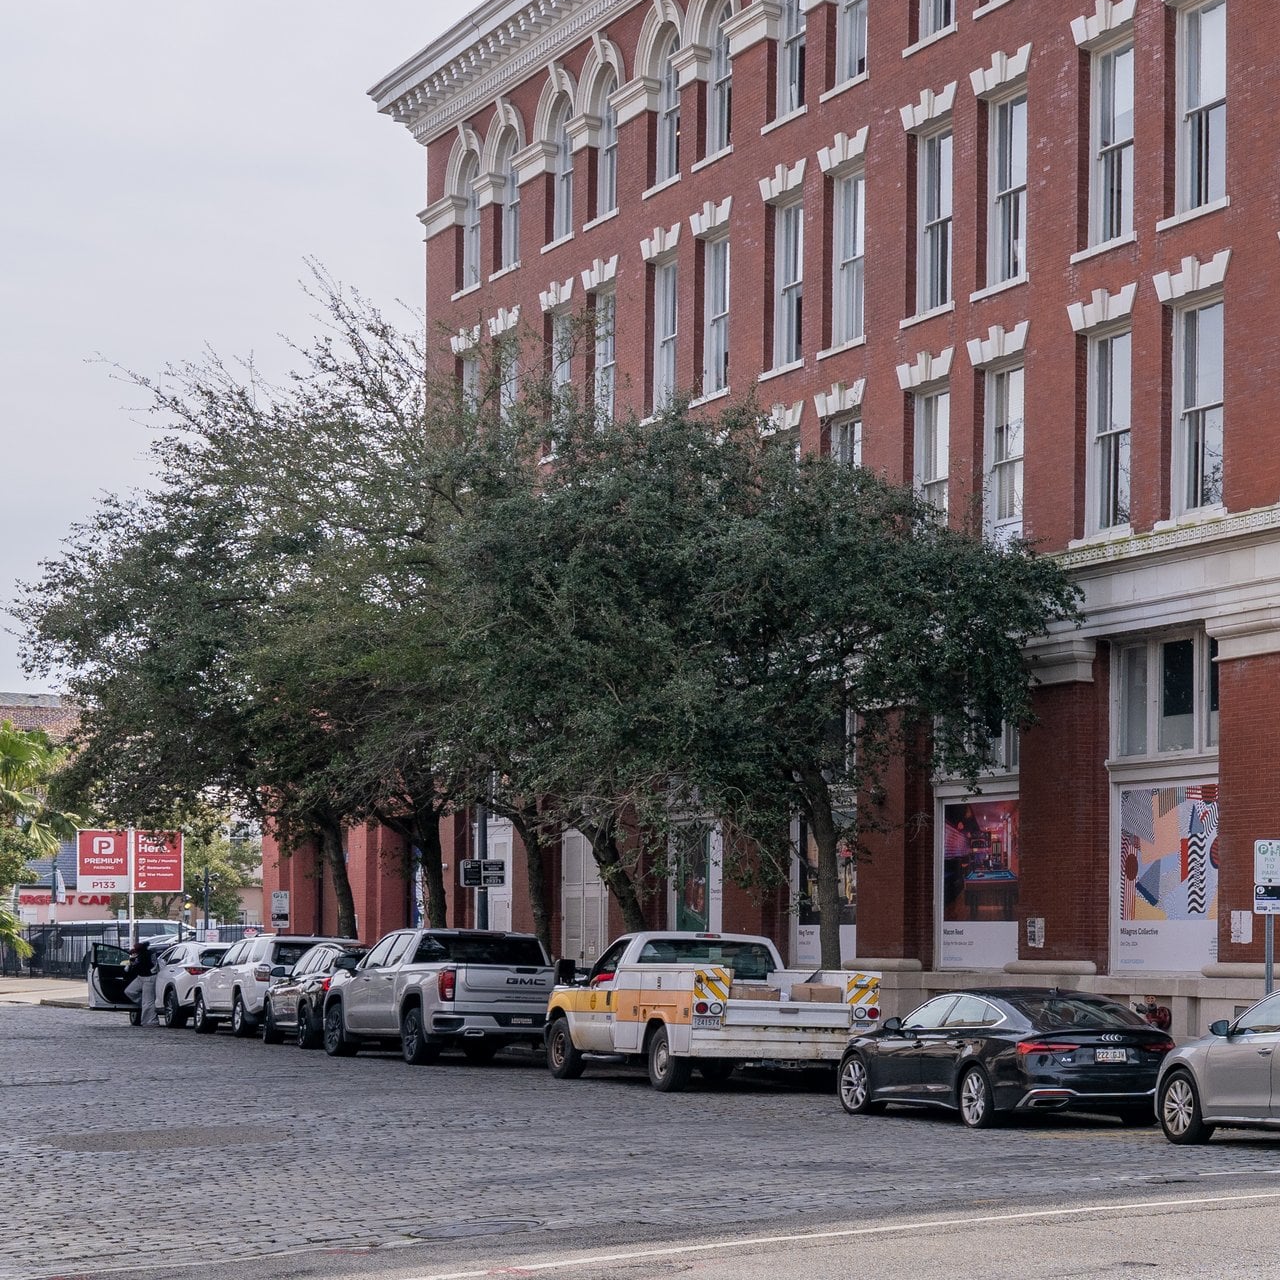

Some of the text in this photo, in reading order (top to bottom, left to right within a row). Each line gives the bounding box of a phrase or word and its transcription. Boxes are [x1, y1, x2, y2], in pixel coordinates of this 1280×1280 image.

[138, 844, 171, 853] Here.
[92, 881, 116, 889] P133
[19, 895, 111, 906] RGET CAR
[1120, 927, 1159, 936] Milagros Collective
[506, 977, 547, 986] GMC
